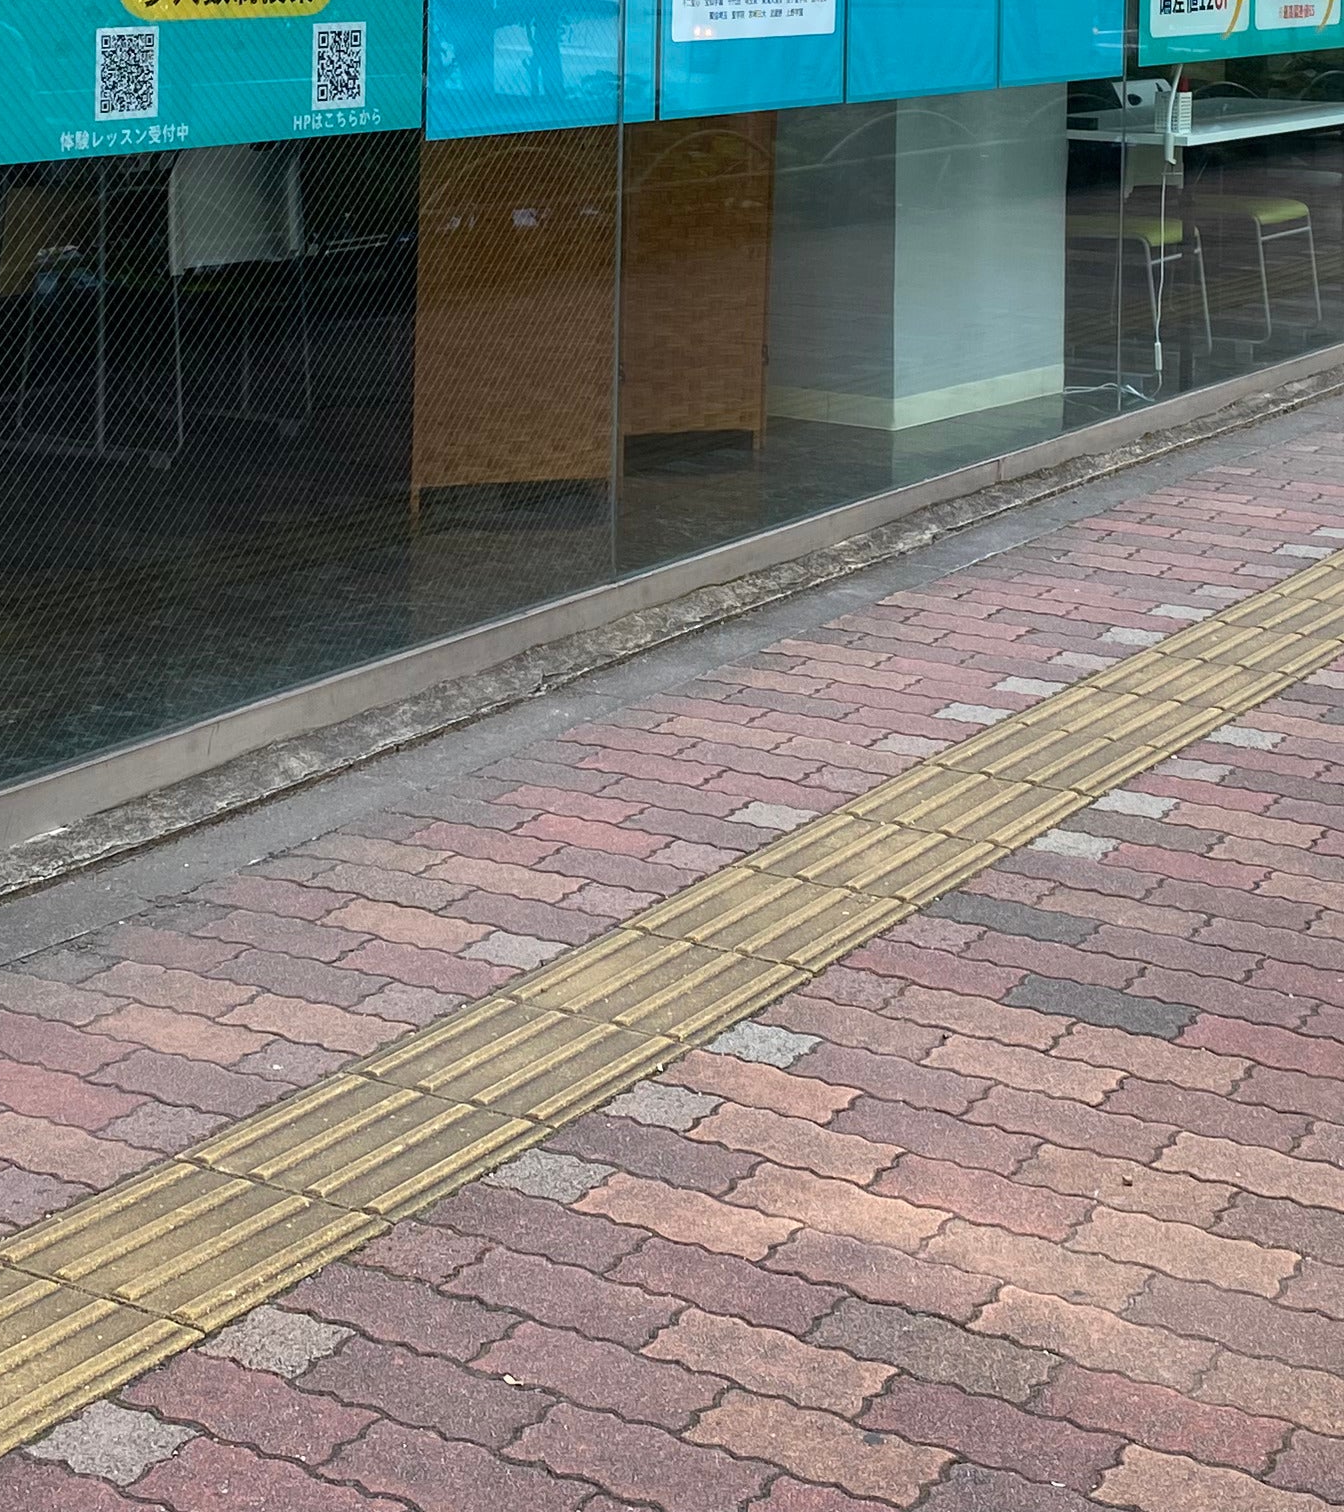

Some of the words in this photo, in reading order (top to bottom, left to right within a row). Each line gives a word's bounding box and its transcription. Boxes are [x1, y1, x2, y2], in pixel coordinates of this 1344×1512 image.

[293, 108, 382, 131] HPはこちらから
[59, 125, 190, 153] 体験レッスン受付中
